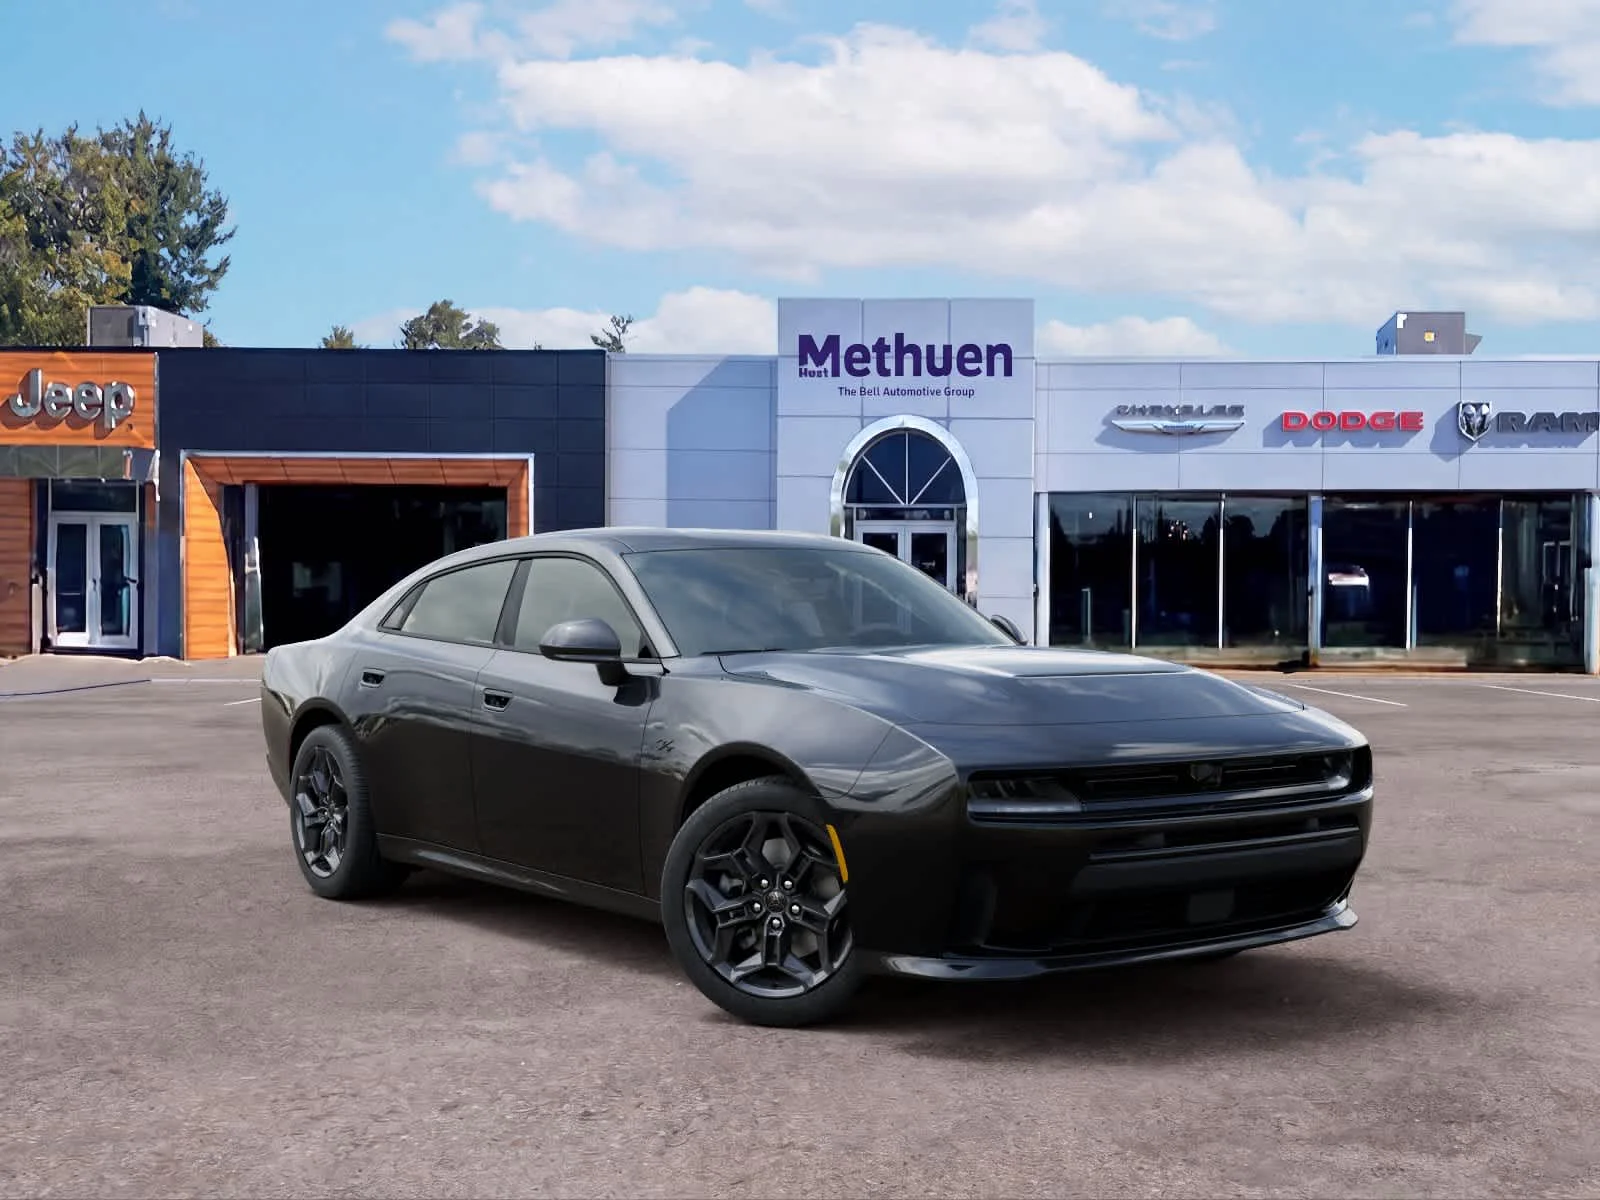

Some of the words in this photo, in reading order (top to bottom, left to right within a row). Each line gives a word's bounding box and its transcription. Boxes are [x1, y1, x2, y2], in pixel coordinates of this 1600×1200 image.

[798, 332, 1013, 377] Methuen
[9, 368, 135, 429] Jeep
[838, 386, 857, 397] The
[859, 386, 880, 397] Bell
[883, 386, 942, 397] Automotive
[943, 386, 975, 399] Group
[1281, 412, 1423, 431] DODGE
[1496, 412, 1600, 433] RAM
